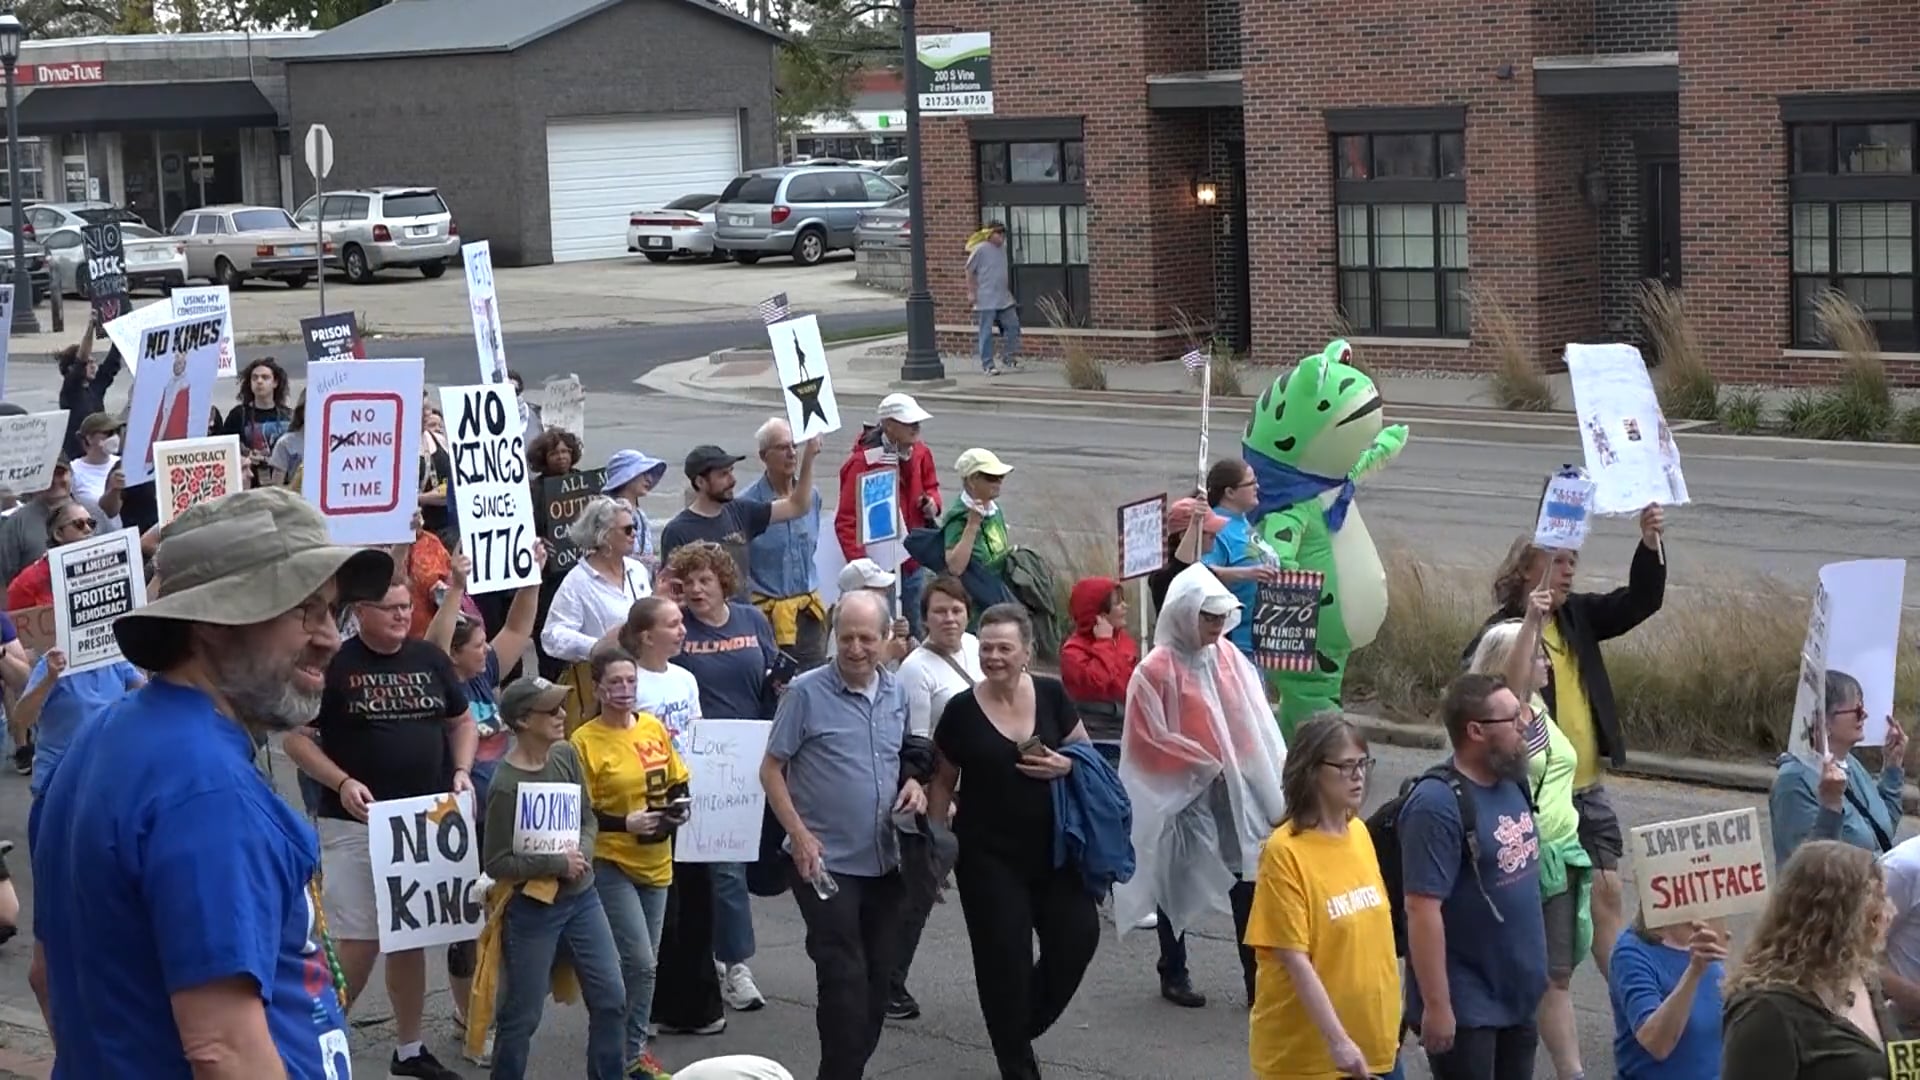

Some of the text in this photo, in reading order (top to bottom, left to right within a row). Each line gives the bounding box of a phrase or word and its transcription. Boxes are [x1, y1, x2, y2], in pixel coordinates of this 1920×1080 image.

[934, 69, 975, 82] 200 S Vine
[929, 83, 934, 92] 2
[925, 95, 986, 107] 217.356.8750
[82, 223, 121, 257] NO
[183, 294, 220, 306] USING MY
[144, 329, 170, 361] NO
[172, 318, 223, 354] KINGS
[310, 324, 352, 342] PRISON
[350, 408, 376, 423] NO
[458, 390, 506, 440] NO
[167, 449, 227, 466] DEMOCRACY
[342, 455, 378, 472] ANY
[452, 436, 525, 487] KINGS
[9, 463, 44, 480] RIGHT
[341, 481, 382, 497] TIME
[561, 475, 589, 493] ALL
[472, 493, 517, 519] SINCE:
[554, 523, 571, 539] CA
[470, 524, 532, 584] 1776
[73, 554, 120, 576] IN AMERICA
[73, 582, 126, 609] PROTECT
[76, 600, 129, 625] DEMOCRACY
[1254, 602, 1318, 627] 1776
[86, 626, 106, 638] FROM
[1253, 623, 1317, 639] NO KINGS IN
[1260, 636, 1306, 651] AMERICA
[349, 671, 432, 688] DIVERSITY
[363, 684, 425, 701] EQUITY
[348, 696, 445, 713] INCLUSION
[520, 791, 546, 831] NO
[388, 810, 469, 866] NO
[1640, 814, 1752, 857] IMPEACH
[1690, 854, 1711, 865] THE
[1650, 862, 1766, 910] SHITFACE
